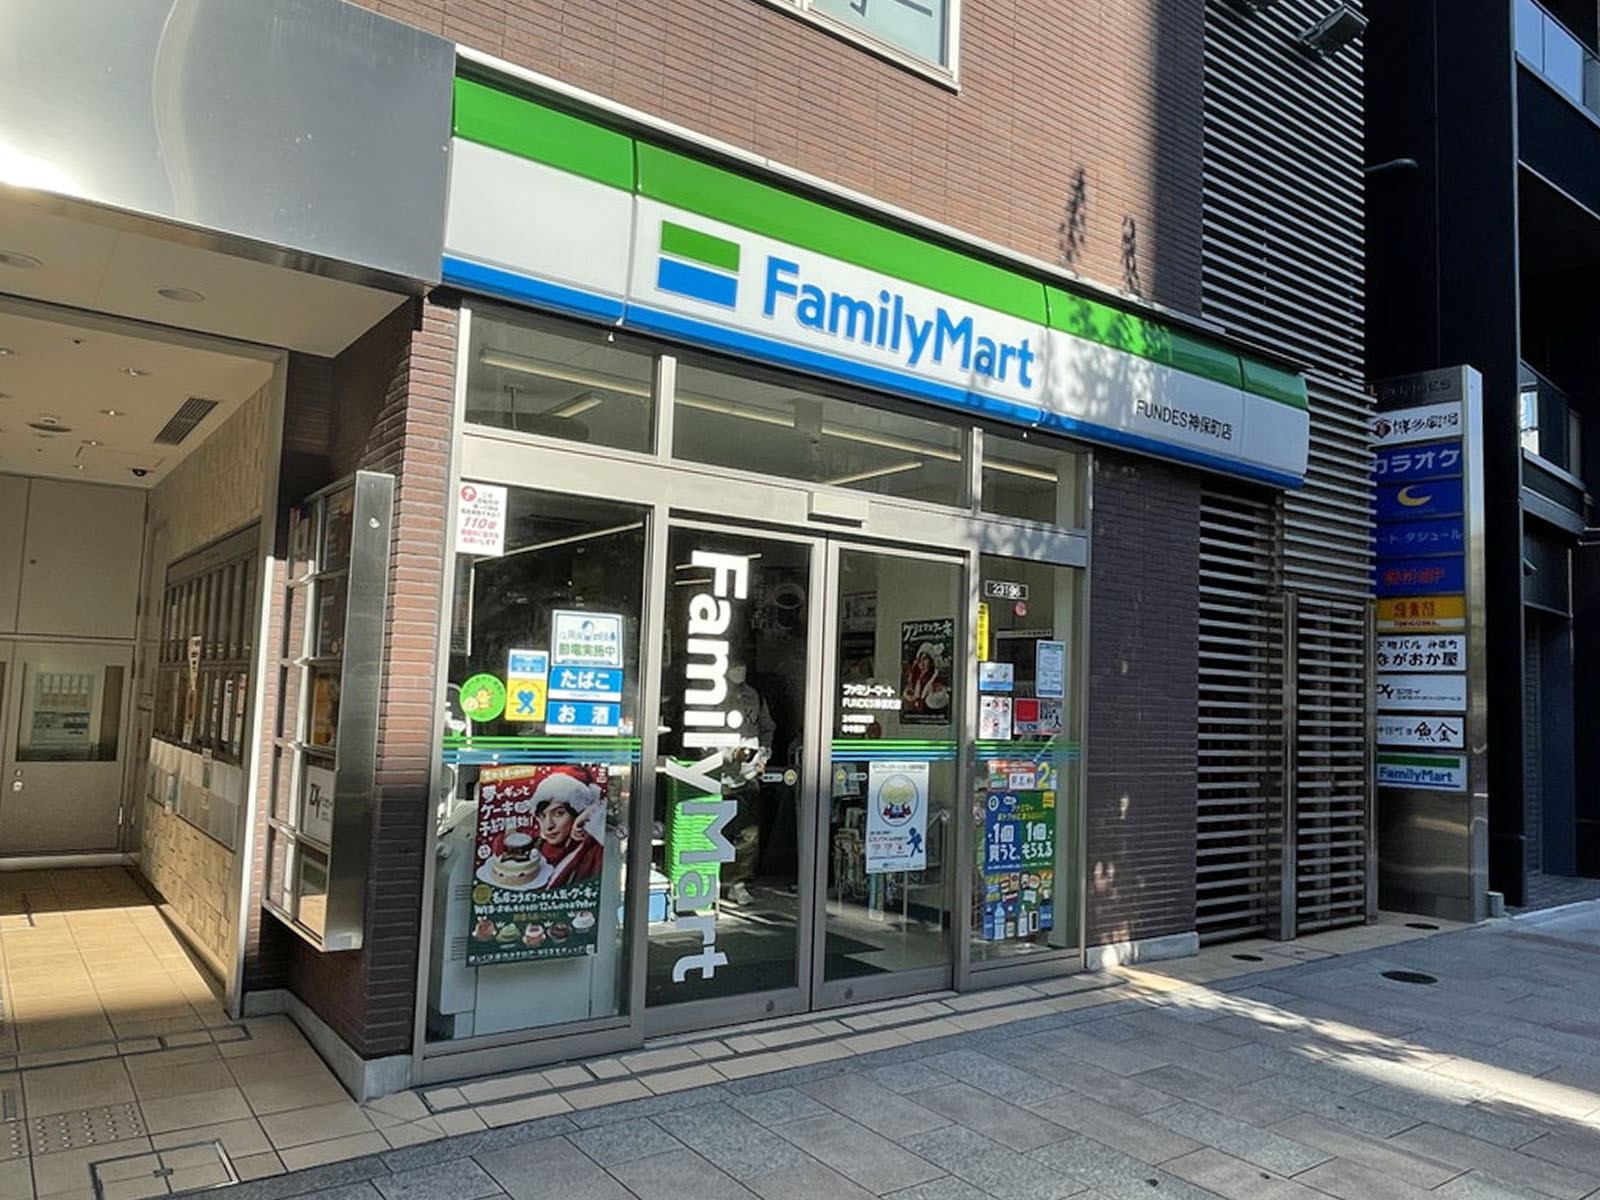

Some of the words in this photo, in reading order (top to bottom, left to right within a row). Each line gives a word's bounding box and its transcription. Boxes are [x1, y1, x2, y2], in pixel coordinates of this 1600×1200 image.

[761, 255, 1034, 389] FamilyMart
[1136, 399, 1233, 441] FUNDES神保町店
[1377, 651, 1459, 667] ながおか屋
[560, 669, 610, 690] たばこ
[1414, 721, 1459, 743] 魚金
[665, 549, 750, 984] FamilyMart
[1378, 767, 1453, 783] FamilyMart
[1021, 841, 1054, 860] もらえる
